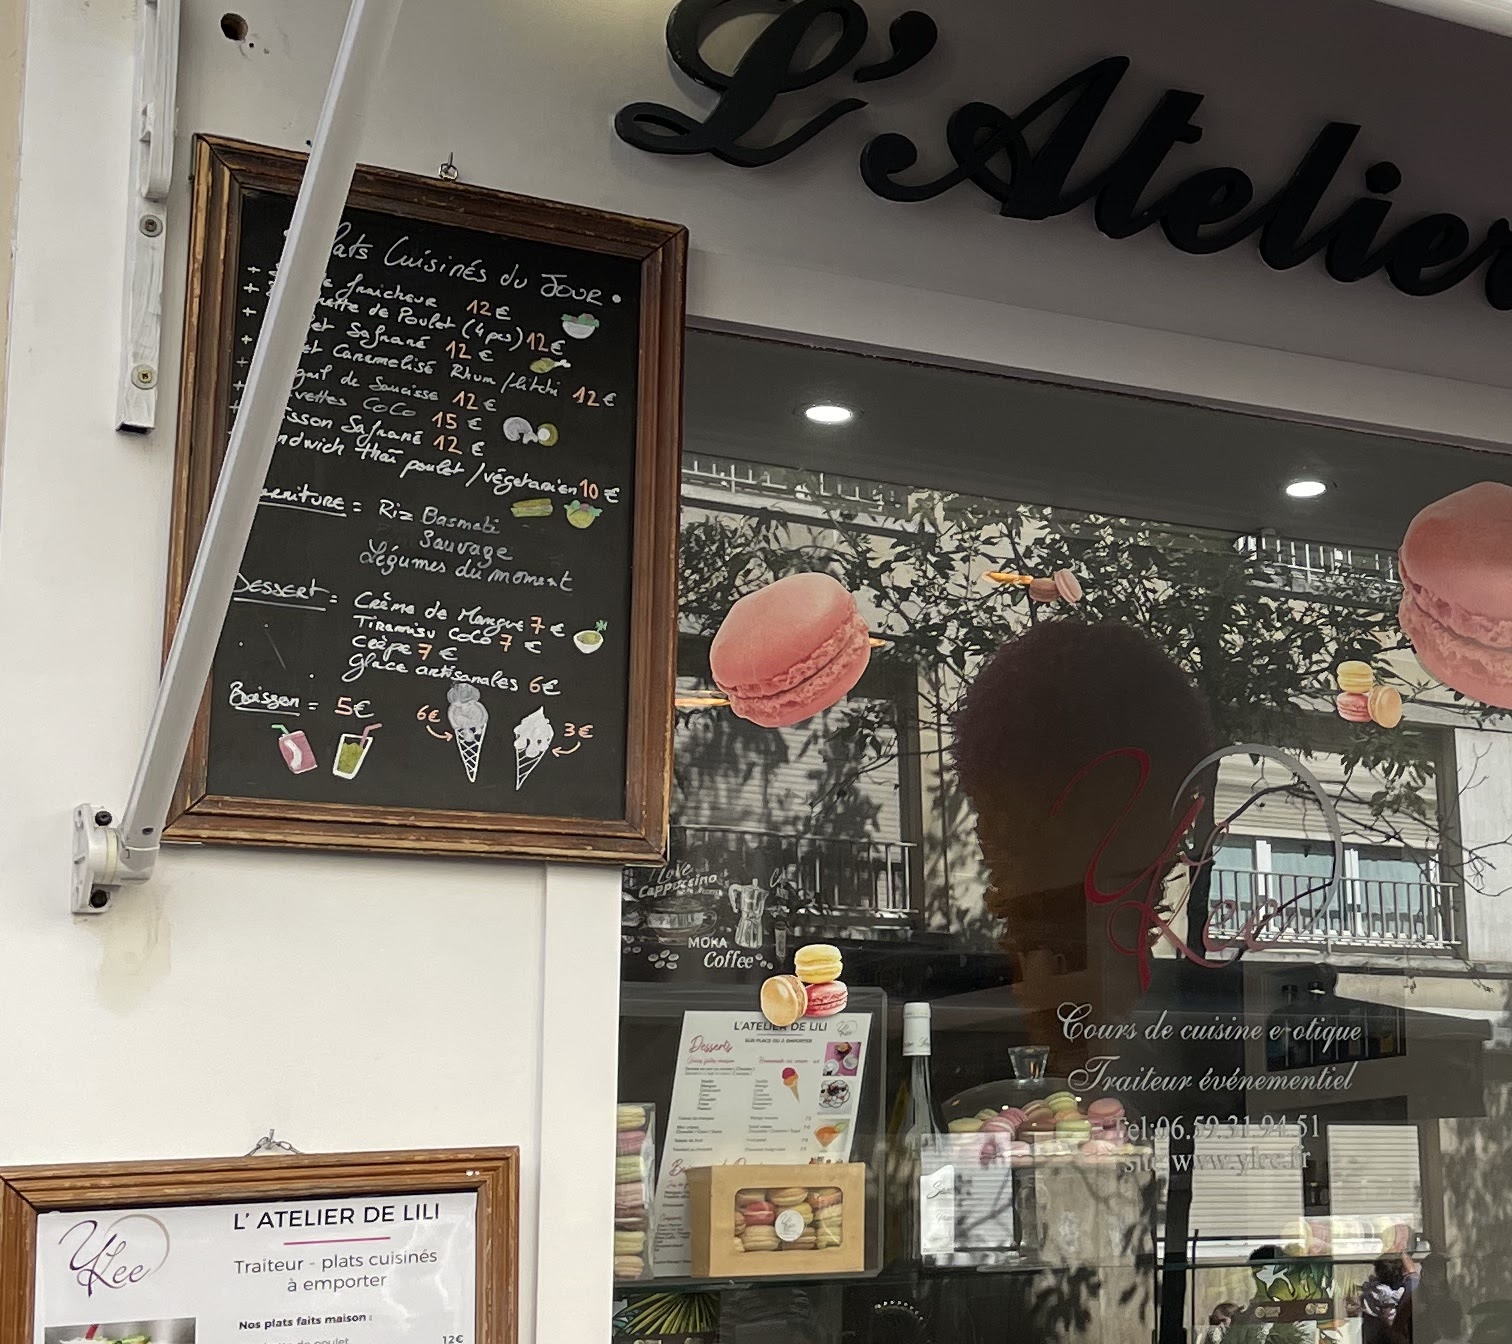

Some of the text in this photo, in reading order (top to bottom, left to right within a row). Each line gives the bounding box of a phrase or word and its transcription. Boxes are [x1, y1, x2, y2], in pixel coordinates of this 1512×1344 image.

[384, 236, 486, 282] Cuisinés
[500, 264, 527, 288] du
[419, 529, 513, 568] Sauvage
[455, 559, 481, 580] du
[425, 601, 448, 620] de
[687, 937, 728, 949] MOKA
[703, 951, 754, 970] Coffee
[790, 1022, 805, 1031] DE
[809, 1022, 828, 1031] LILI
[1056, 1001, 1137, 1043] Cours
[1144, 1009, 1173, 1041] de
[1180, 1015, 1263, 1041] cuisine
[688, 1035, 733, 1054] Desserts
[1067, 1055, 1358, 1092] Traiteur événementiel
[257, 1208, 354, 1229] ATELIER
[363, 1205, 395, 1223] DE
[403, 1203, 439, 1220] LILI
[234, 1249, 438, 1274] Traiteur plats cuisinés
[287, 1275, 387, 1292] à emporter
[239, 1314, 366, 1330] Nos plats faits maison
[442, 1335, 464, 1344] 12€
